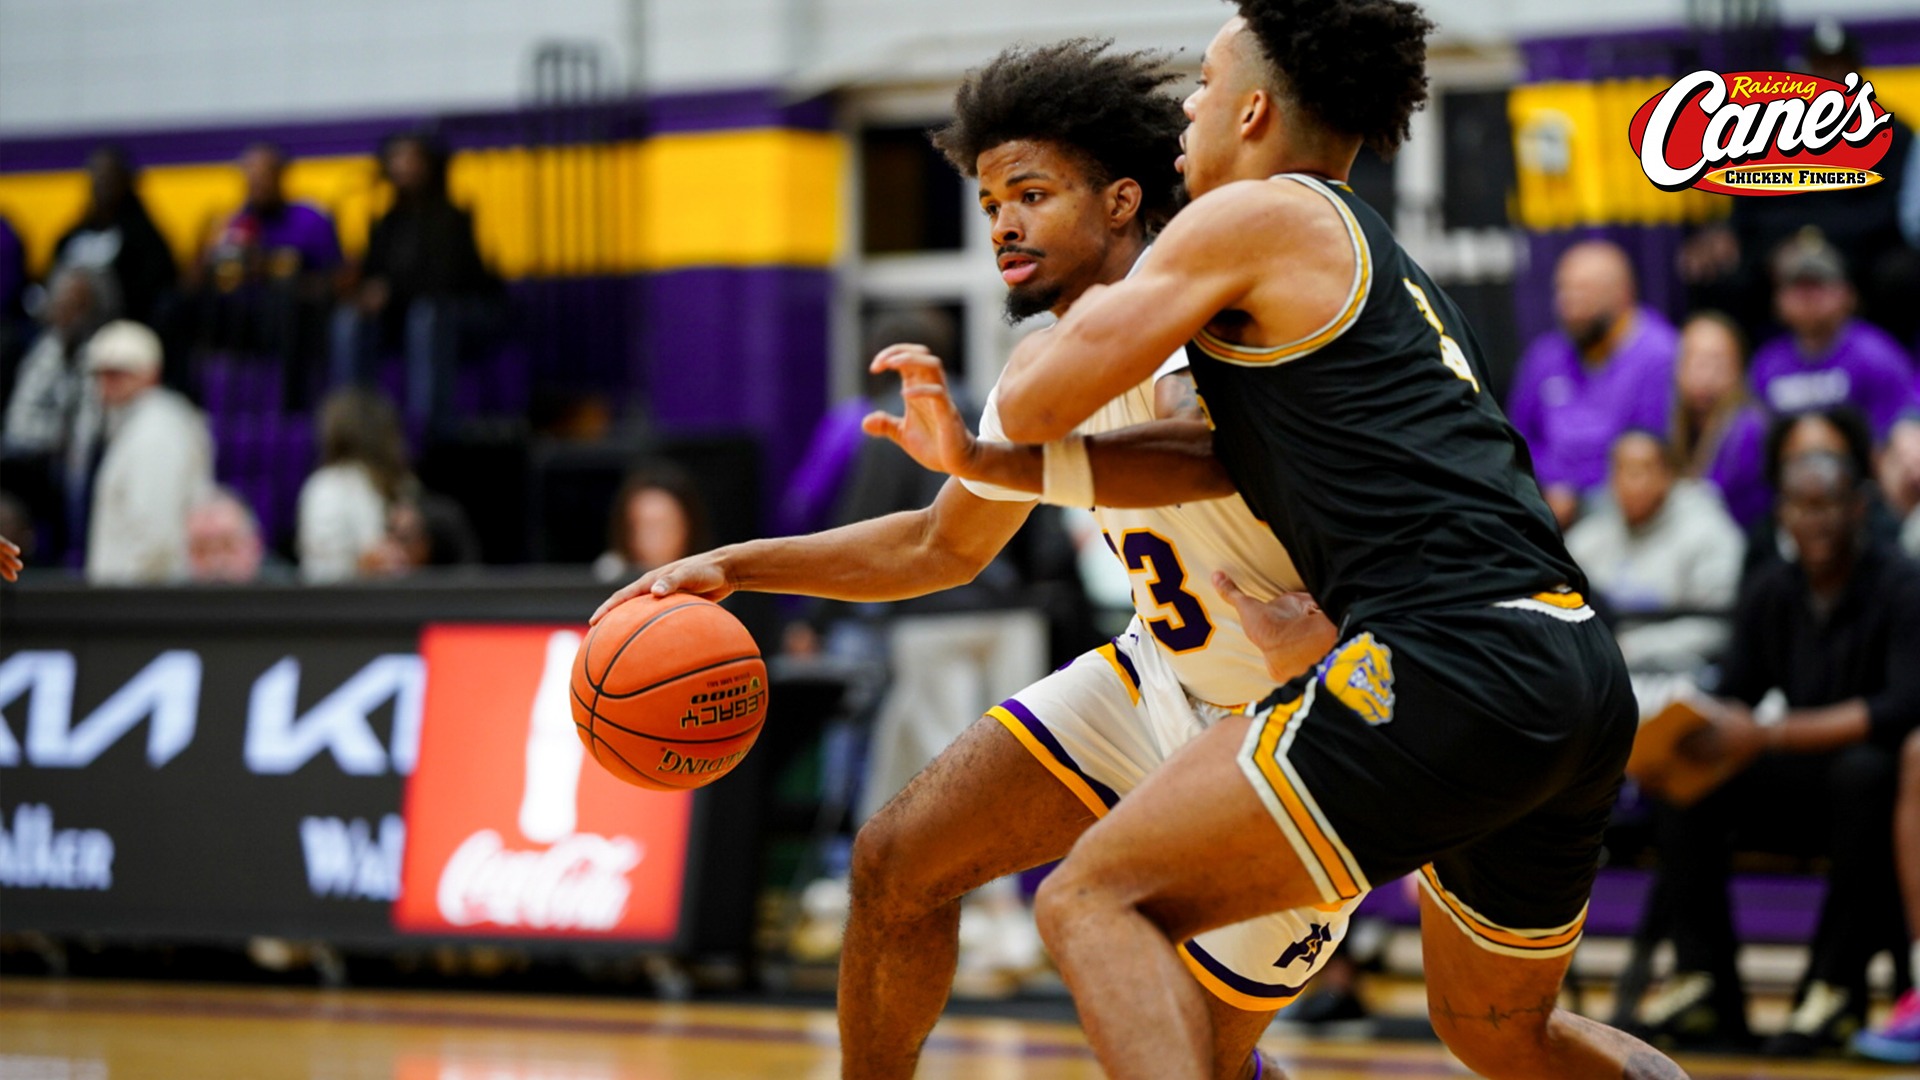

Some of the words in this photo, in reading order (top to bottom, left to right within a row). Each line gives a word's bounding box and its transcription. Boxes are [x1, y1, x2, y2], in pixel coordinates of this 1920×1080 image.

[1101, 527, 1217, 656] 3
[0, 649, 204, 770] IA
[243, 653, 428, 777] KI
[680, 690, 766, 728] LEGACY
